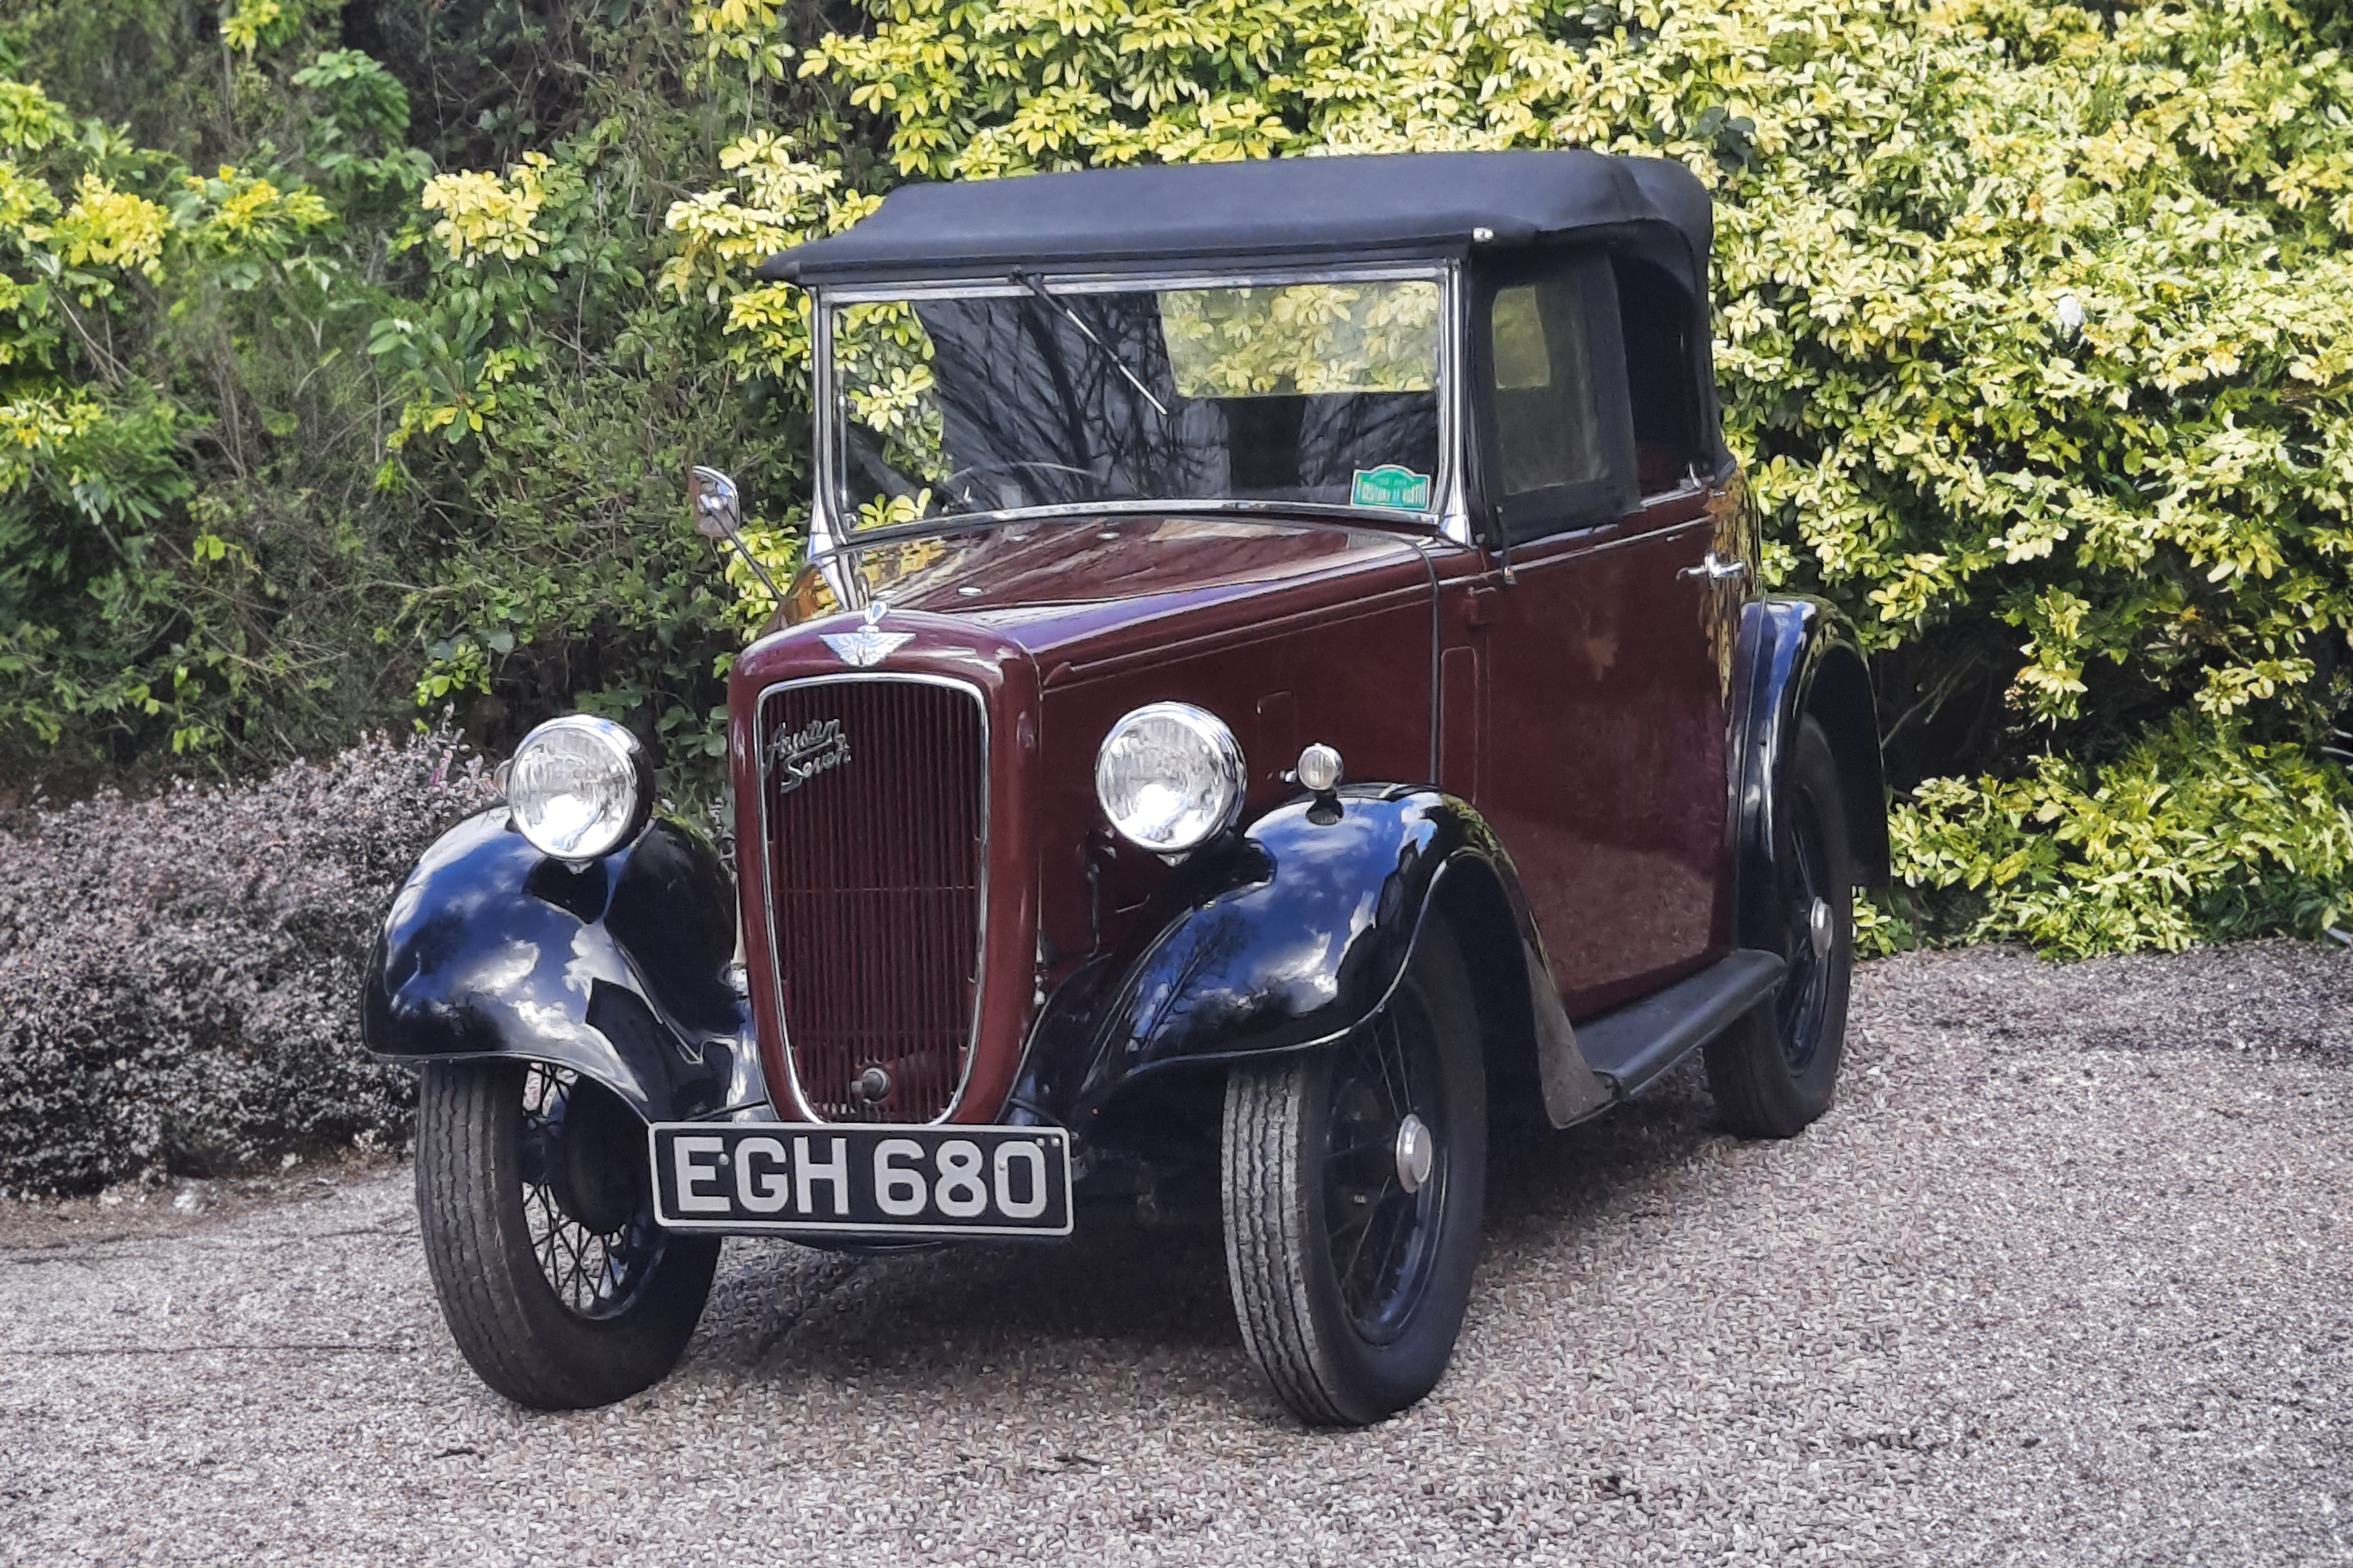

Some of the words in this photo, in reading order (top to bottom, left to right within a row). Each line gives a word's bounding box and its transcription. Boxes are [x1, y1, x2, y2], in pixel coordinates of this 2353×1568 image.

[780, 737, 851, 794] Seven
[674, 1137, 850, 1214] EGH
[874, 1139, 1047, 1218] 680
